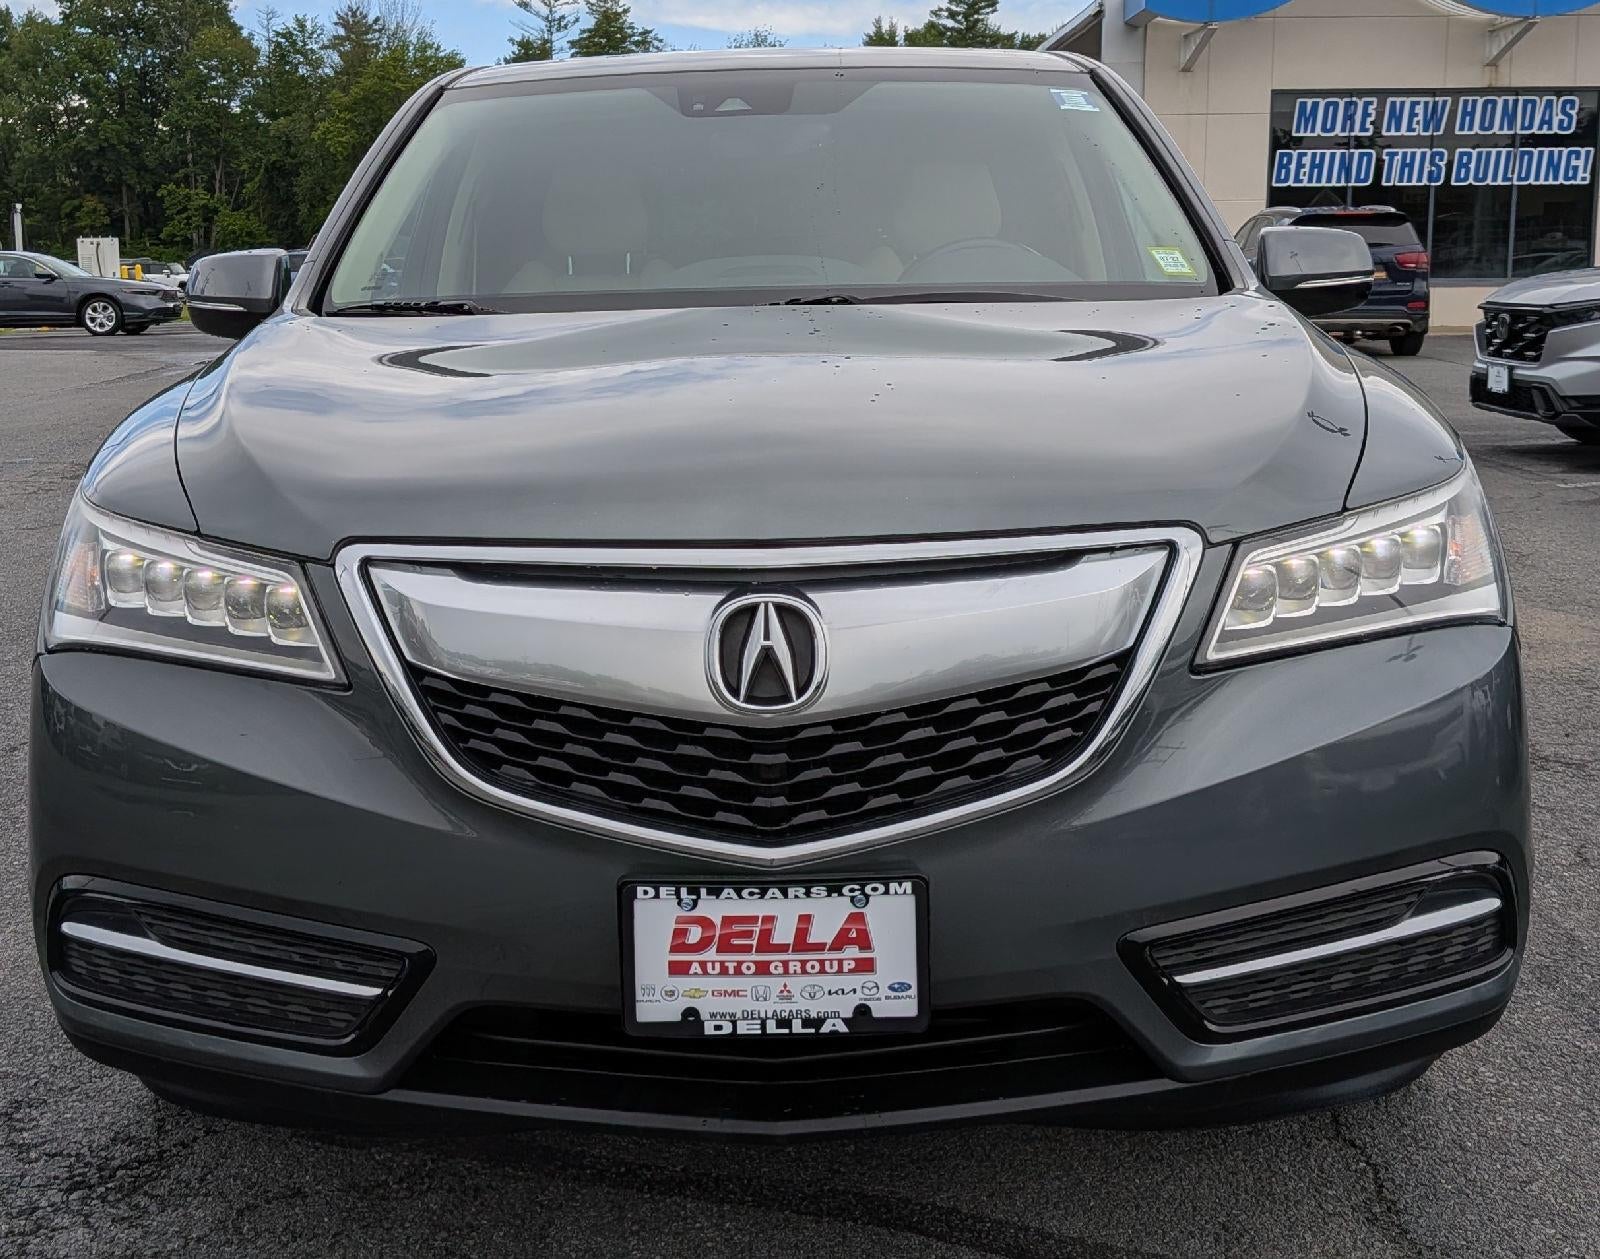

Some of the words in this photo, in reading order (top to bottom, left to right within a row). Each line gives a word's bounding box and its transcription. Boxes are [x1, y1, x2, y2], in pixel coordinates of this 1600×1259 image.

[1292, 97, 1377, 136] MORE
[1382, 97, 1451, 136] NEW
[1455, 96, 1579, 135] HONDAS
[1273, 149, 1376, 187] BEHIND
[1382, 149, 1447, 187] THIS
[1451, 148, 1594, 185] BUILDING!
[636, 881, 913, 900] DELLACARS.COM
[668, 911, 875, 955] DELLA
[689, 961, 757, 975] AUTO
[769, 959, 857, 974] GROUP
[711, 989, 748, 998] GMC
[708, 1008, 841, 1020] www.DELLACARS.com
[703, 1018, 850, 1035] DELLA
